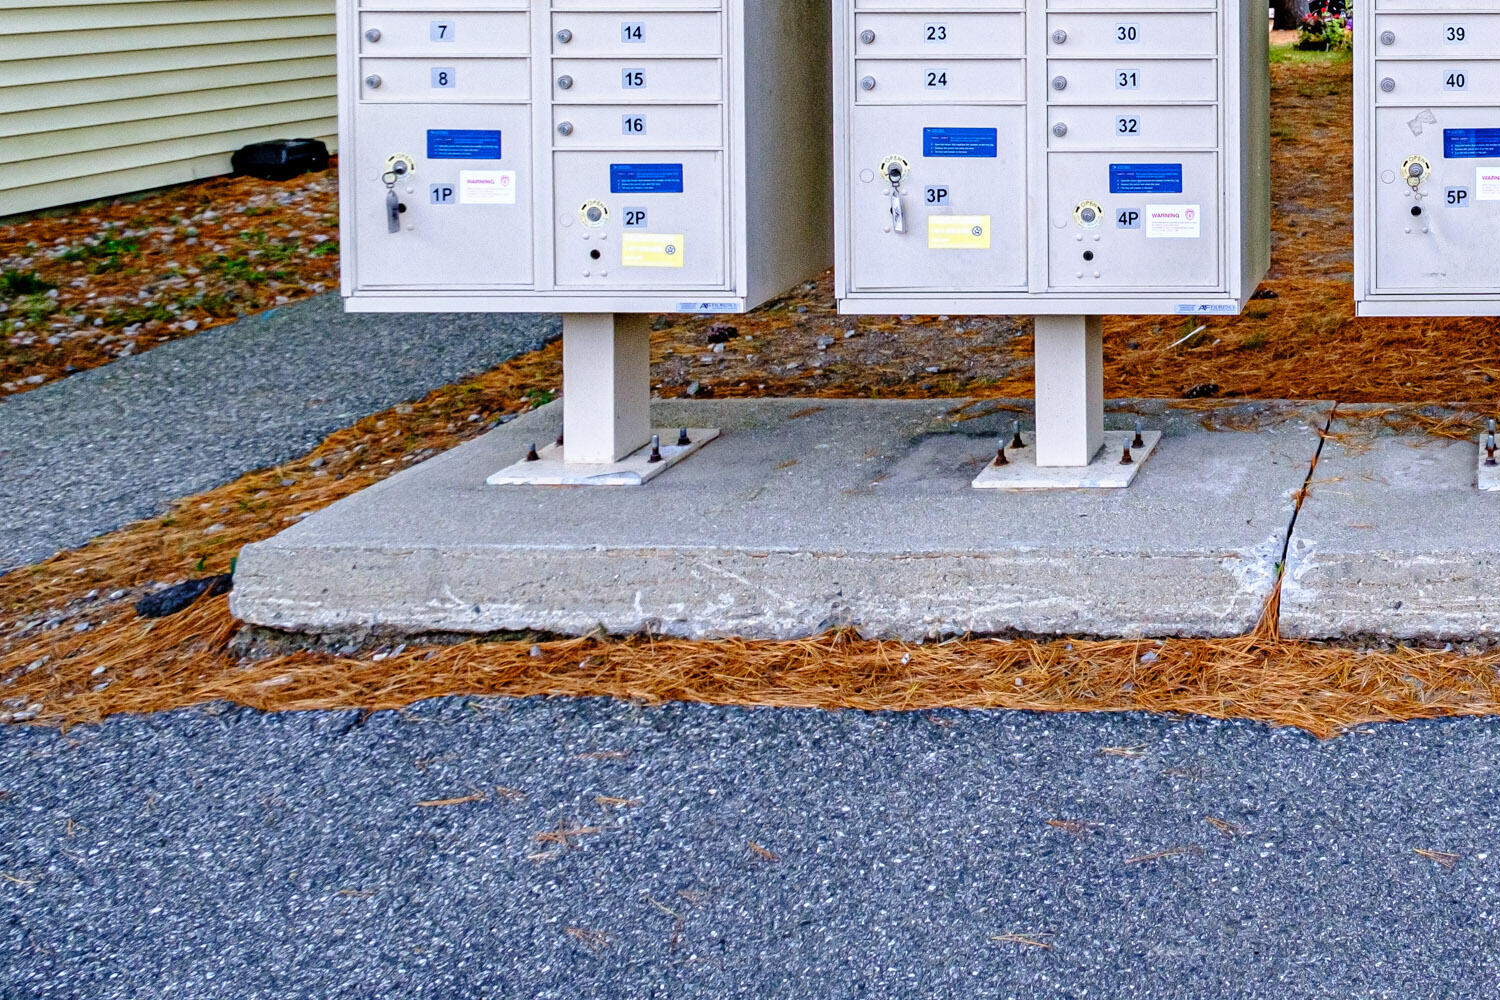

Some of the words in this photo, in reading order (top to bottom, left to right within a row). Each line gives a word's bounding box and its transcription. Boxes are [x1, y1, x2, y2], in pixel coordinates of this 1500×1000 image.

[437, 24, 448, 39] 7
[624, 25, 643, 40] 14
[926, 25, 947, 41] 23
[1117, 26, 1137, 41] 30
[1446, 26, 1466, 42] 39
[438, 71, 449, 86] 8
[624, 71, 644, 87] 15
[927, 71, 948, 87] 24
[1119, 72, 1137, 87] 31
[1445, 73, 1465, 88] 40
[624, 117, 644, 133] 16
[1118, 118, 1138, 133] 32
[432, 187, 453, 202] 1P
[926, 188, 948, 204] 3P
[1446, 189, 1468, 205] 5P
[625, 210, 646, 226] 2P
[1117, 211, 1139, 226] 4P
